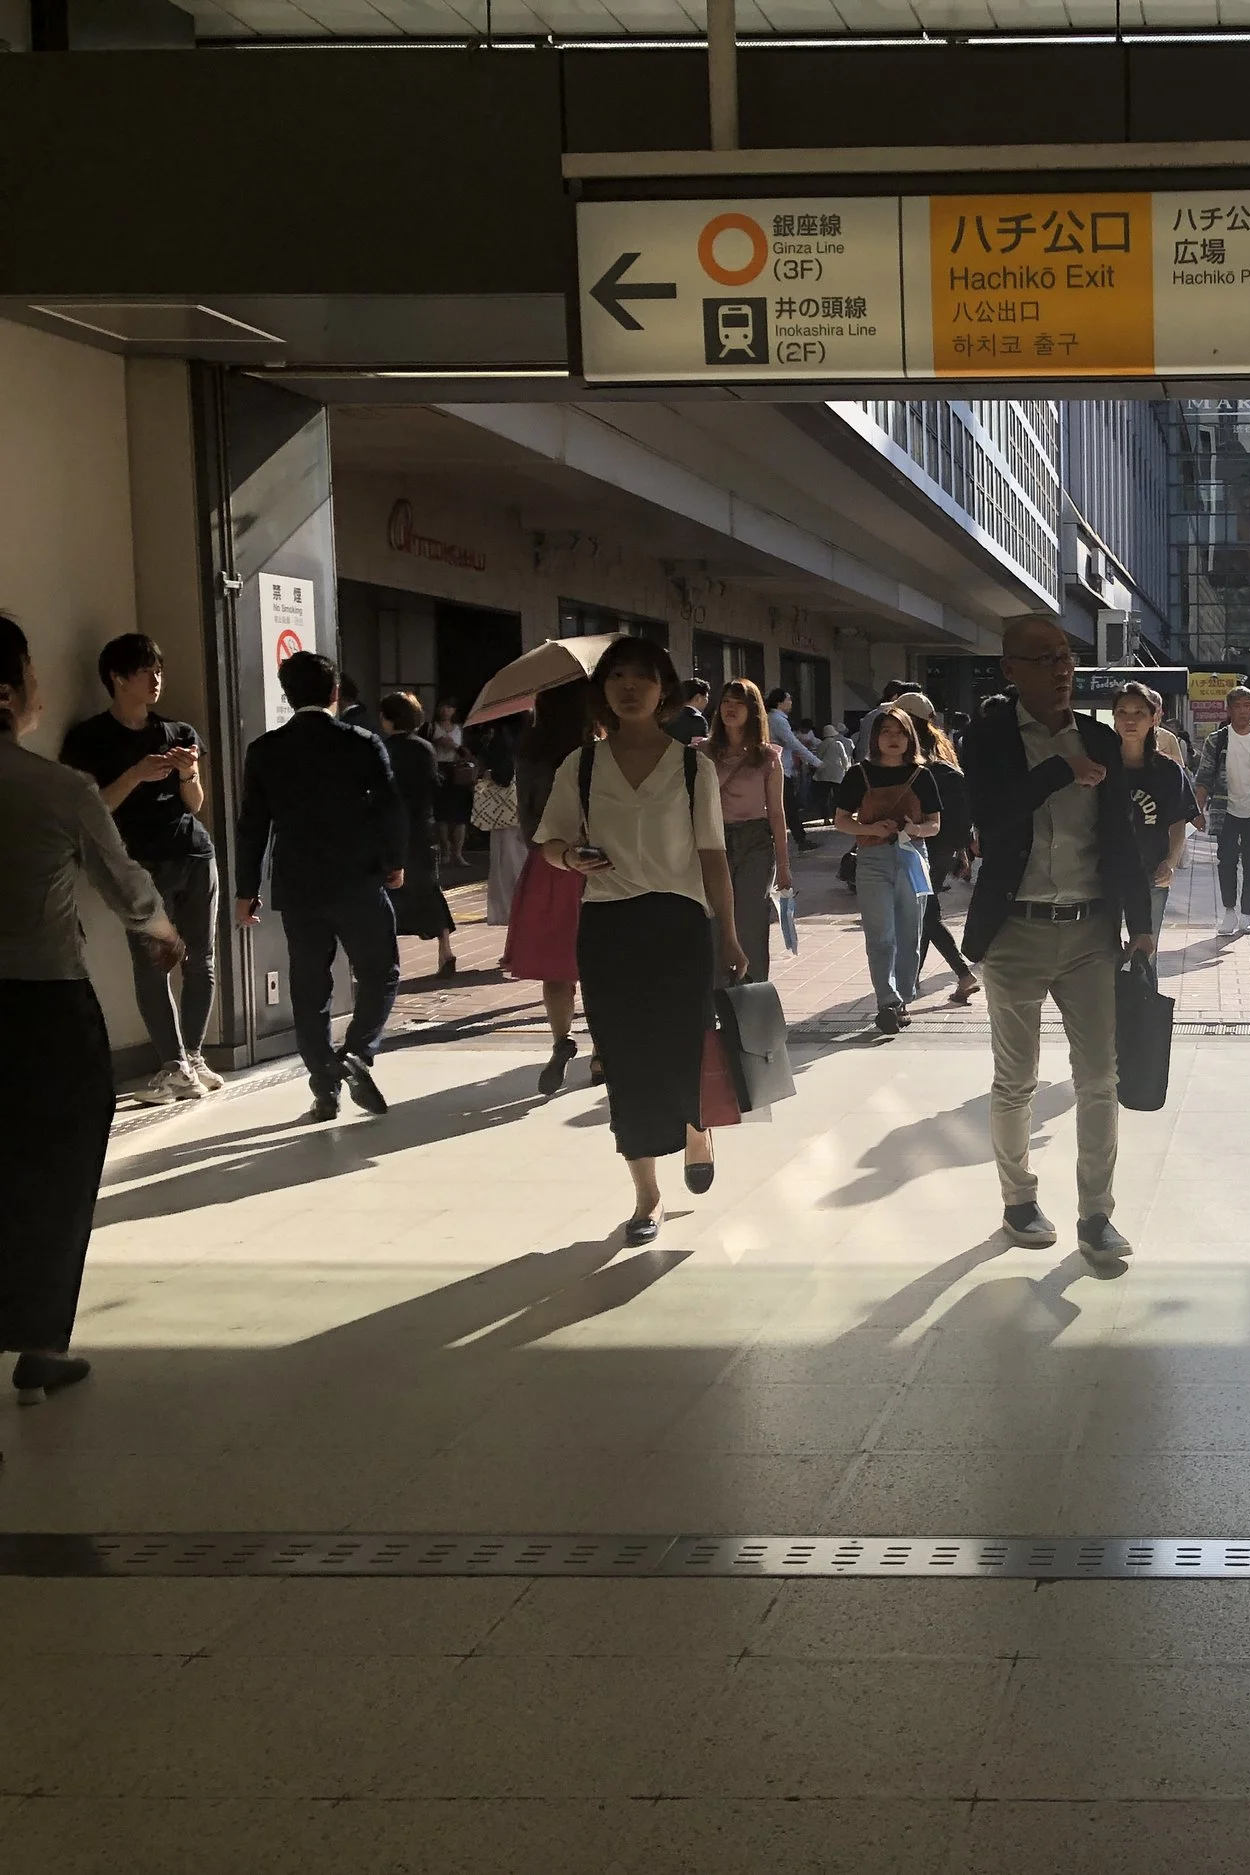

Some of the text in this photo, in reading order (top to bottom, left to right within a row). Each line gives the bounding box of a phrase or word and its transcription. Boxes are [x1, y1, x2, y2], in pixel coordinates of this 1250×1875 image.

[772, 214, 842, 237] 銀座線
[950, 209, 1130, 254] ハチ公口
[772, 241, 845, 255] Ginza Line
[1173, 238, 1226, 265] 広場
[773, 258, 823, 282] (3F)
[950, 264, 1115, 290] Hachikō Exit
[1172, 270, 1235, 285] Hachikō
[775, 297, 867, 320] 井の頭線
[952, 300, 1040, 323] 八公出口
[775, 323, 877, 337] Inokashira Line
[775, 341, 826, 365] (2F)
[952, 332, 1079, 357] 하치코 출구
[273, 603, 303, 616] No Smoking
